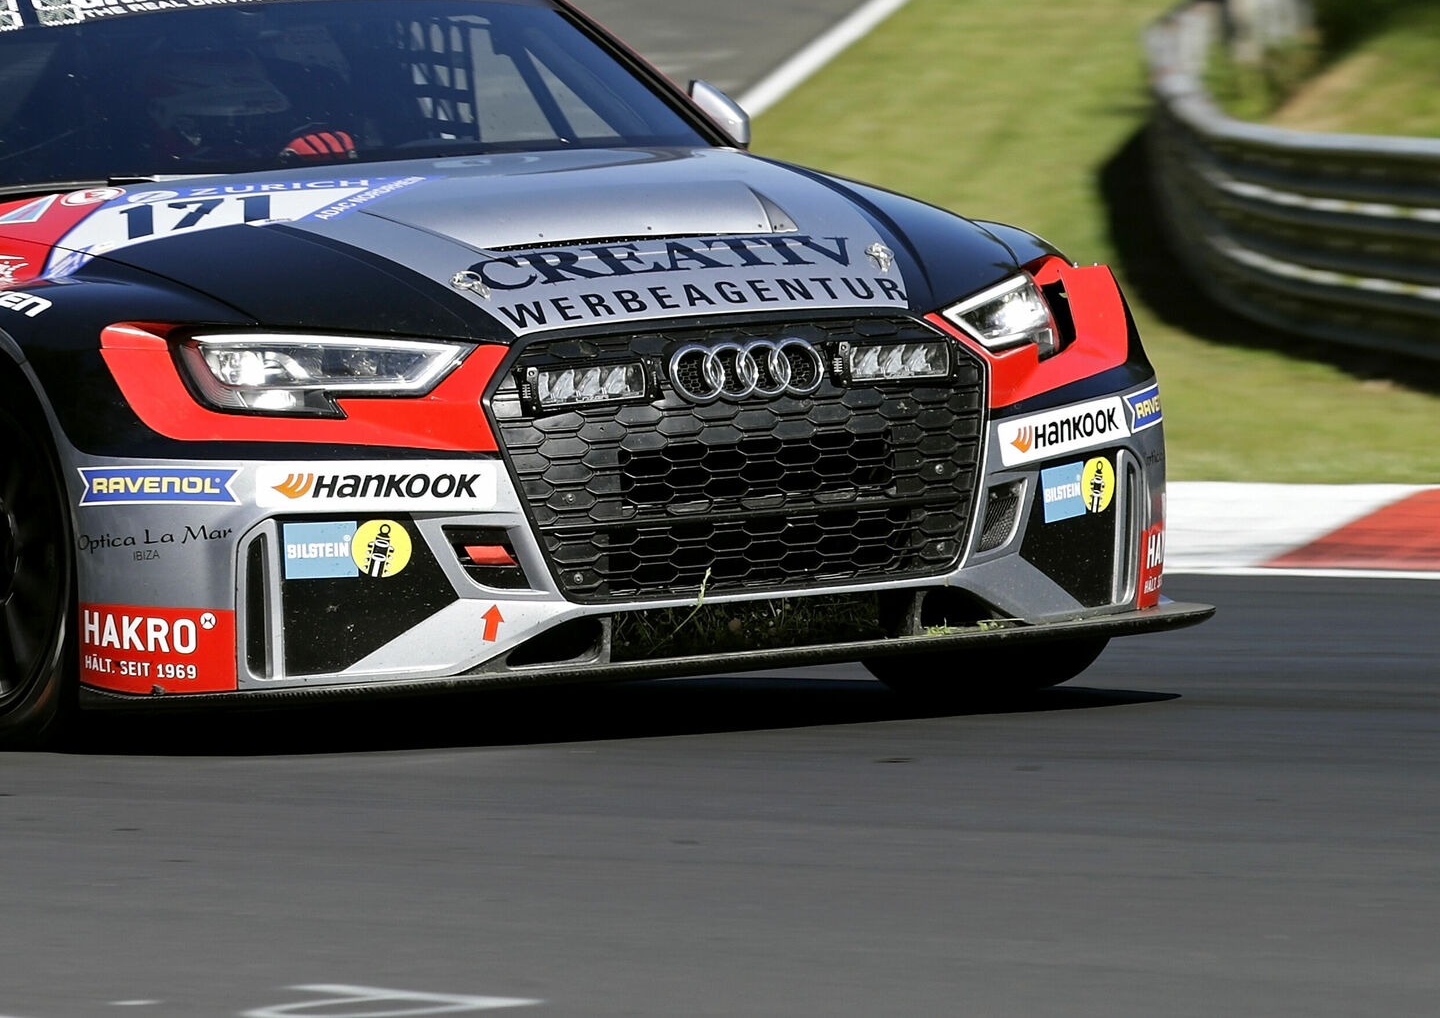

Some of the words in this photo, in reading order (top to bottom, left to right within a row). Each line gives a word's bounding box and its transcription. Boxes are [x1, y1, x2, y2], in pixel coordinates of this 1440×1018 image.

[79, 5, 129, 21] THE
[190, 179, 369, 196] ZURICH
[119, 195, 271, 241] 171
[466, 234, 852, 293] CREATIV
[497, 277, 908, 330] WERBEAGENTUR
[91, 476, 221, 494] RAVENOL
[1044, 481, 1082, 504] BILSTEIN
[77, 533, 137, 555] Optica
[143, 528, 175, 545] La
[181, 524, 233, 545] Mar
[286, 540, 350, 560] BILSTEIN
[132, 549, 161, 562] IBIZA
[83, 609, 198, 655] HAKRO
[119, 660, 151, 678] SEIT
[155, 663, 198, 680] 1969
